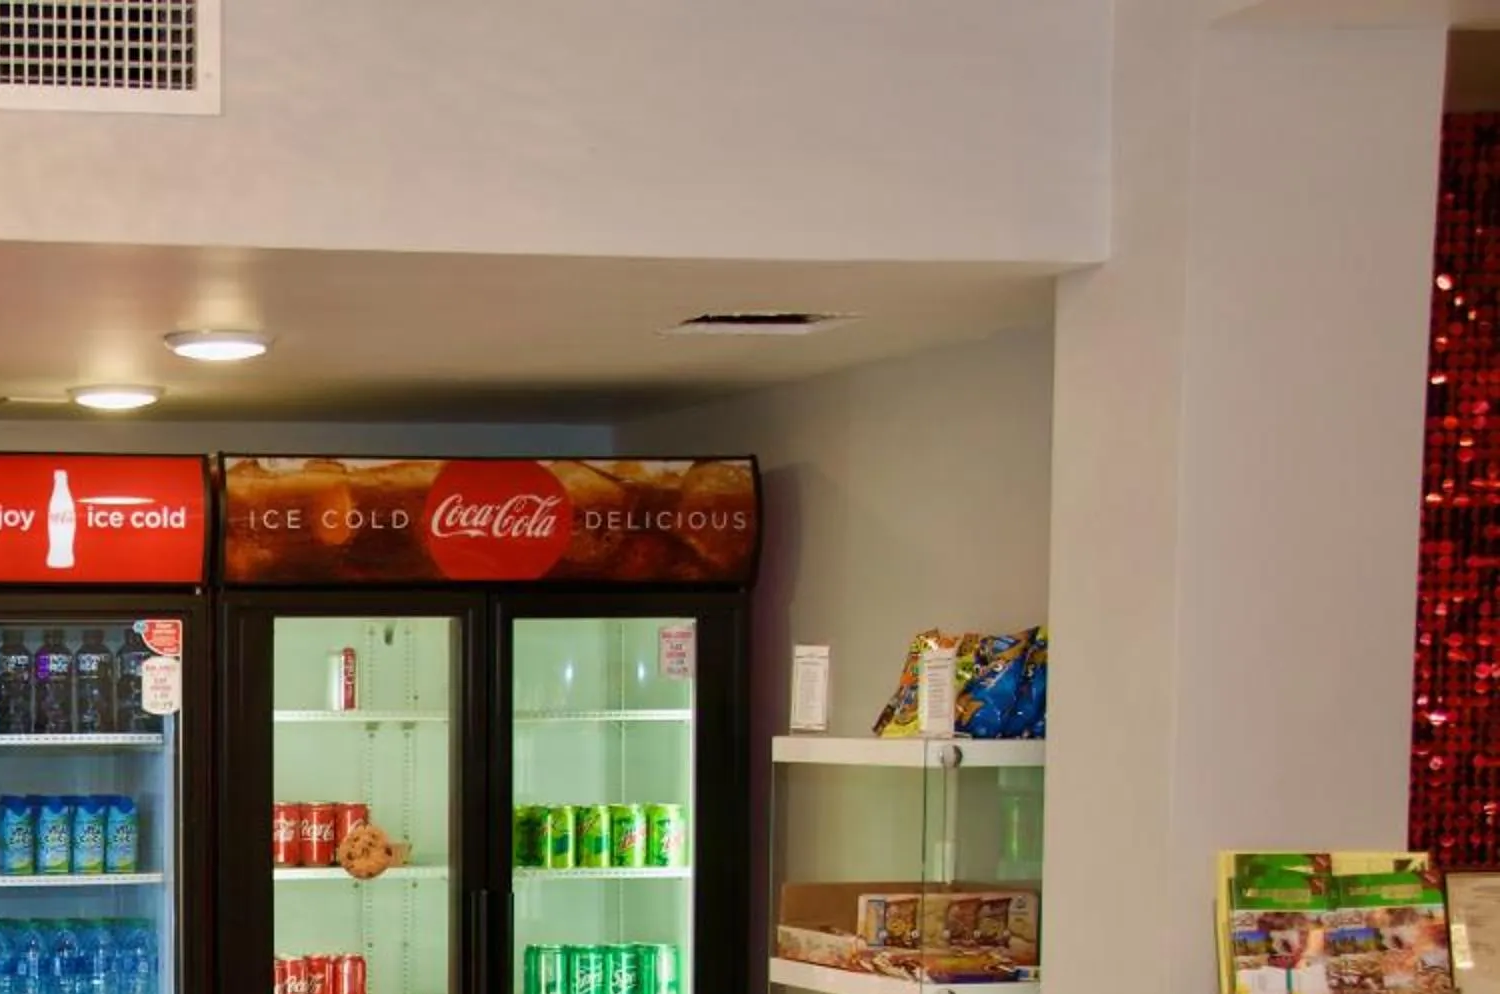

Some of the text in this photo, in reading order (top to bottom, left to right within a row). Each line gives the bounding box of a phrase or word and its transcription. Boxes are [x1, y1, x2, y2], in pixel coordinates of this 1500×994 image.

[86, 505, 124, 529] ice
[131, 504, 186, 529] cold
[249, 509, 410, 530] ICE COLD
[431, 493, 564, 539] Coca-Cola
[585, 510, 748, 531] DELICIOUS
